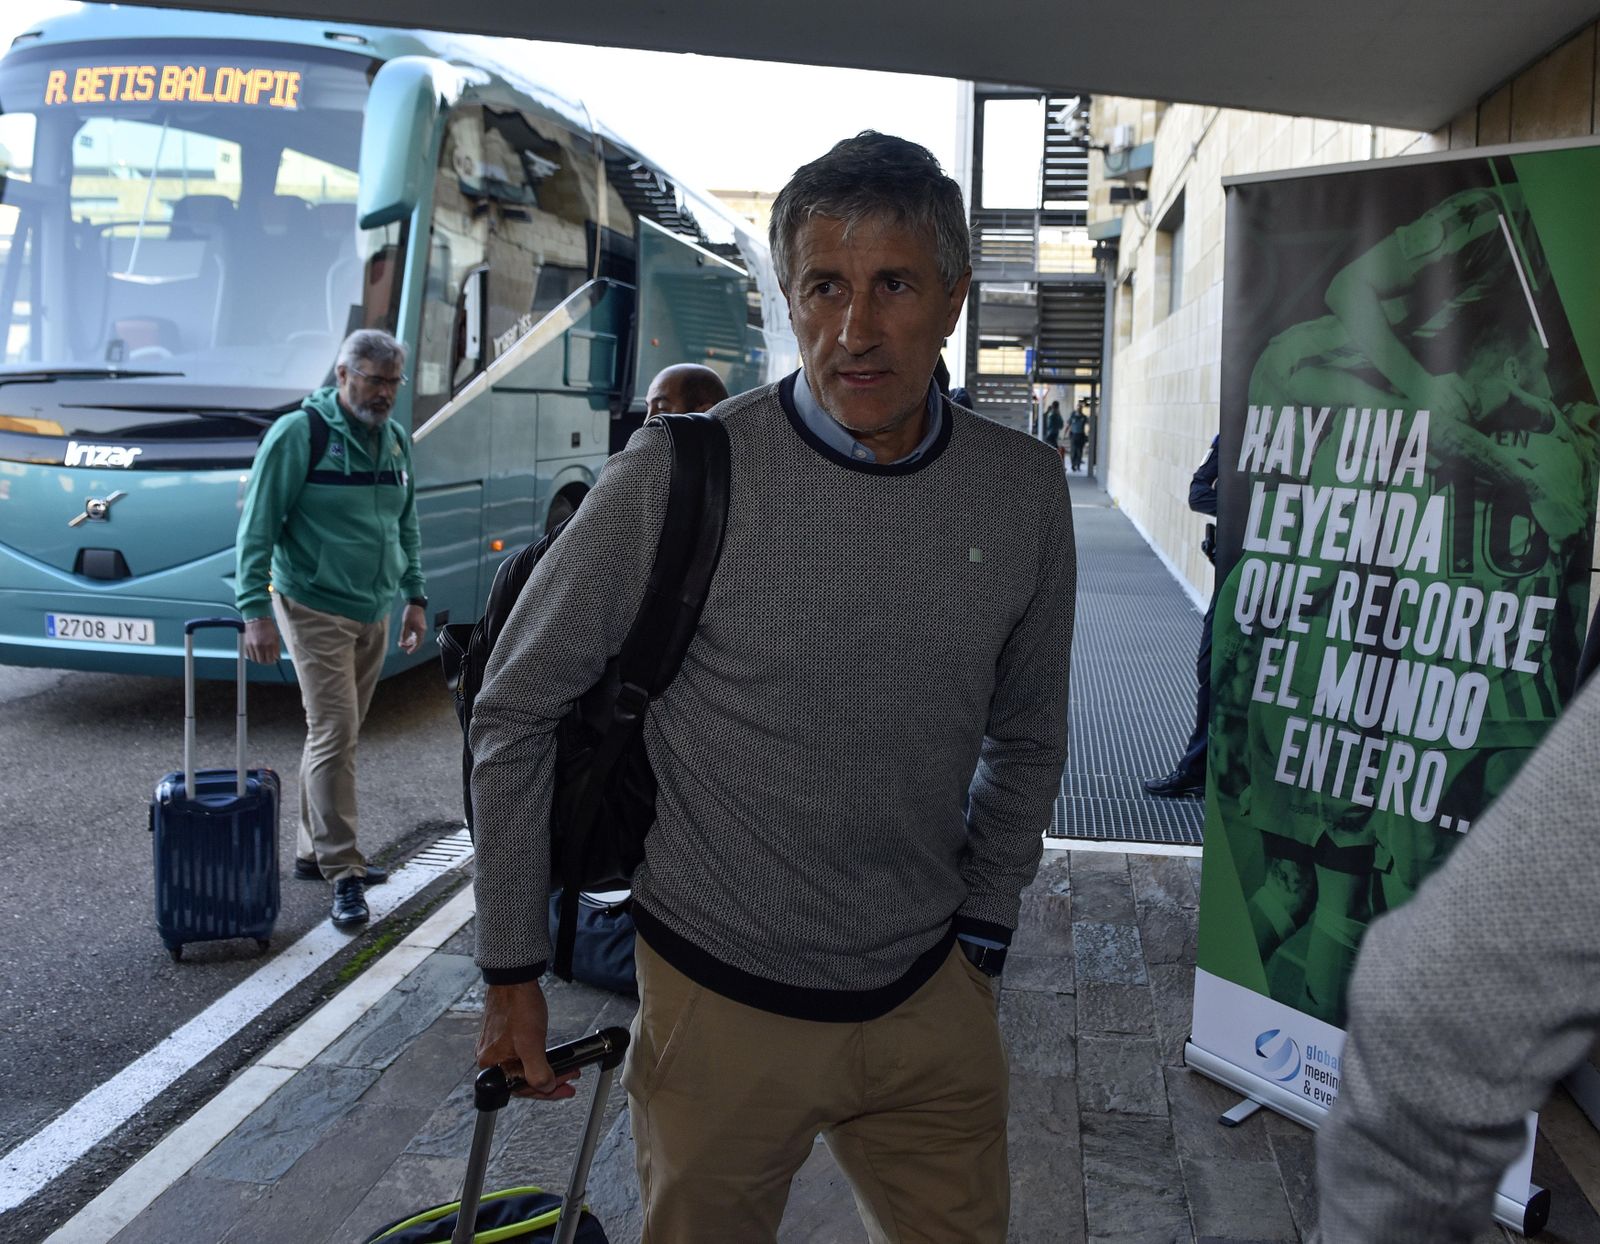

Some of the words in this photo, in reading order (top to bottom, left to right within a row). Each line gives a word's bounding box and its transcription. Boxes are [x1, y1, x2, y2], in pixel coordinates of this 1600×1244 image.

[45, 69, 67, 105] R.
[72, 65, 156, 104] BETIS
[159, 66, 300, 108] BALOMPIE
[1237, 405, 1331, 476] HAY
[1335, 408, 1430, 487] UNA
[1242, 481, 1445, 574] LEYENDA
[59, 618, 105, 640] 2708
[113, 623, 148, 642] JYJ
[1234, 558, 1321, 635] QUE
[1326, 570, 1557, 674] RECORRE
[1251, 637, 1299, 709] EL
[1312, 646, 1490, 750] MUNDO
[1303, 1079, 1311, 1096] &
